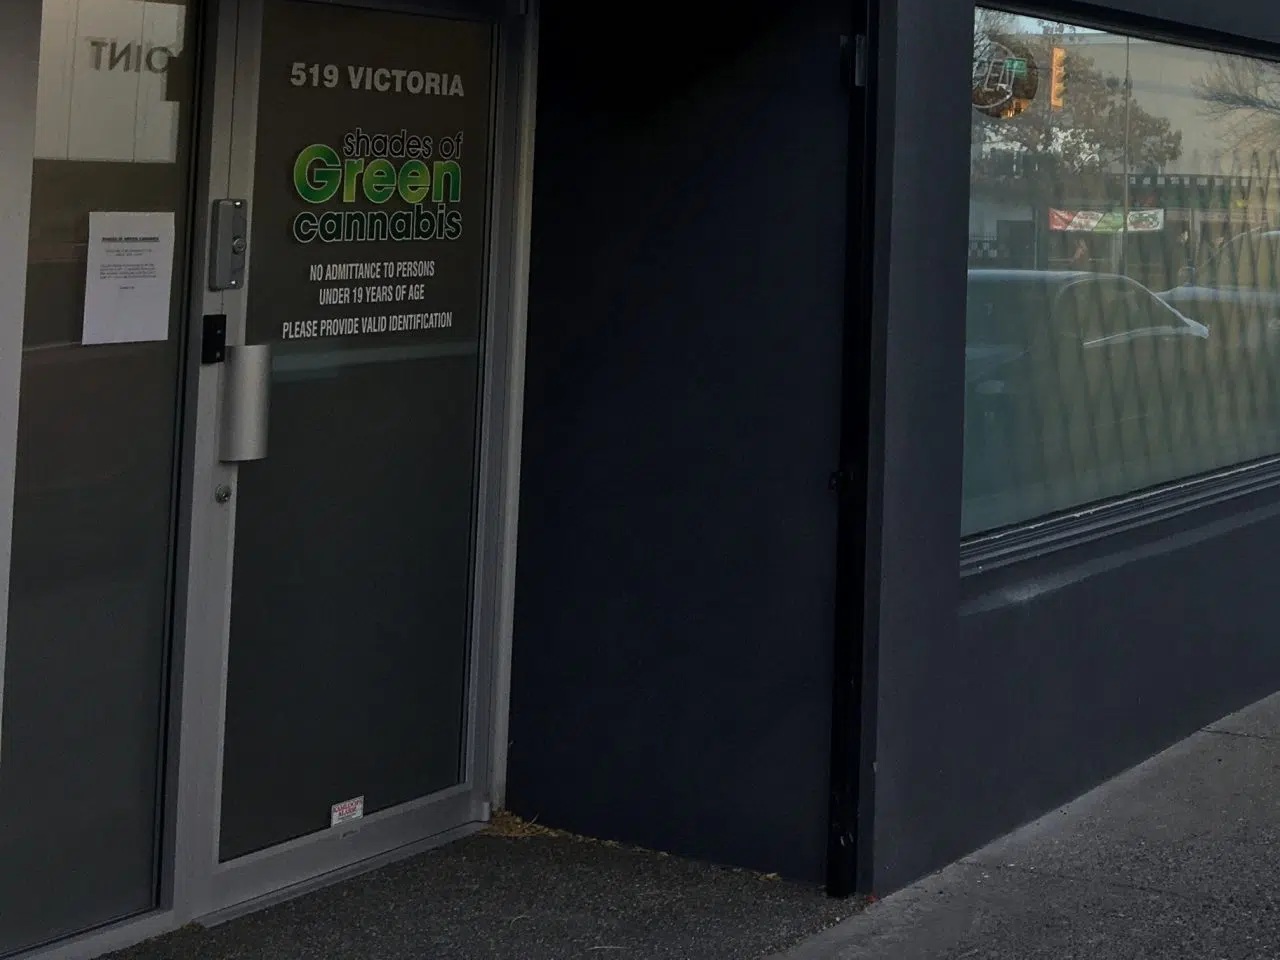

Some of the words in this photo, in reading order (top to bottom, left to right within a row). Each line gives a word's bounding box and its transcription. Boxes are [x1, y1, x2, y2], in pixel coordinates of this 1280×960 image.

[290, 62, 339, 88] 519
[347, 65, 465, 97] VICTORIA
[343, 128, 433, 159] shades
[439, 131, 464, 159] of
[294, 143, 462, 204] Green
[293, 203, 463, 243] cannabis
[310, 264, 324, 281] NO
[325, 262, 381, 281] ADMITTANCE
[383, 262, 394, 278] TO
[396, 260, 435, 278] PERSONS
[319, 288, 350, 305] UNDER
[352, 287, 363, 303] 19
[365, 286, 393, 302] YEARS
[395, 285, 407, 301] OF
[408, 284, 425, 300] AGE
[282, 321, 318, 339] PLEASE
[320, 317, 359, 336] PROVIDE
[361, 315, 387, 333] VALID
[388, 311, 453, 331] IDENTIFICATION
